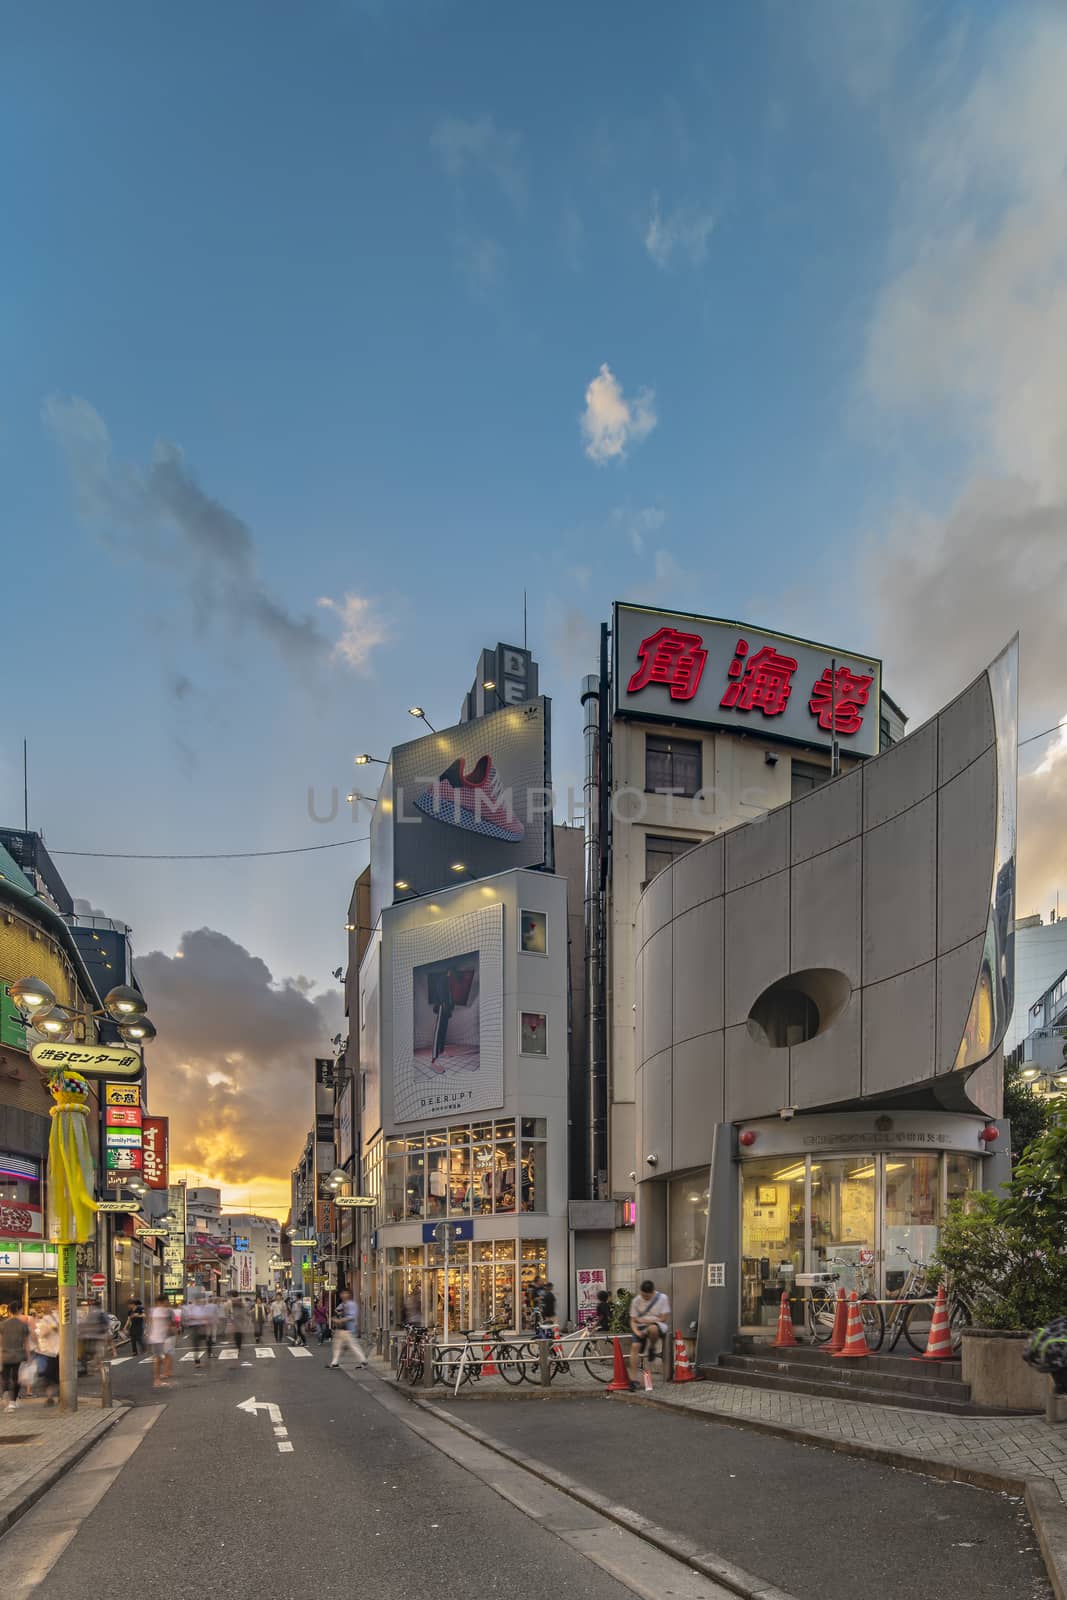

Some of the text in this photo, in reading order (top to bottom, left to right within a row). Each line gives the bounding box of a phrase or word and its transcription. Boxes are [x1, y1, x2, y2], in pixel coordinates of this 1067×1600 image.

[627, 626, 874, 735] 角海老
[37, 1049, 136, 1067] 渋谷センター街
[421, 1091, 472, 1106] DEERUPT
[107, 1137, 140, 1145] FamilyMart
